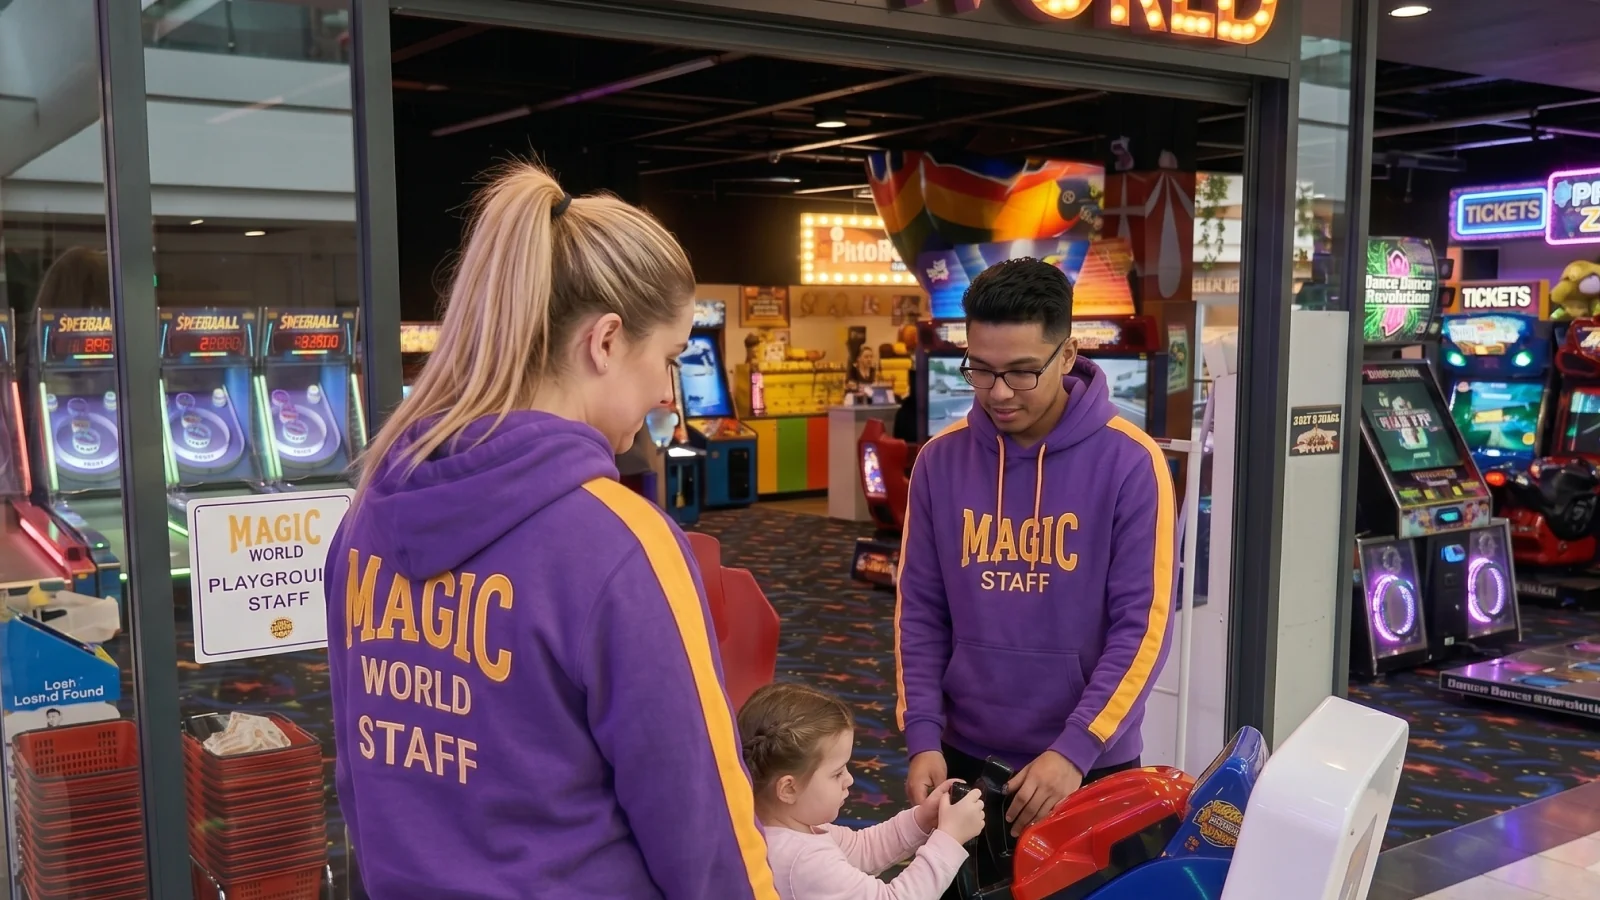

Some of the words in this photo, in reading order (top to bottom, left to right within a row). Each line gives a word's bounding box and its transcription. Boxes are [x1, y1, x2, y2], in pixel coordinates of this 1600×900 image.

[1465, 200, 1540, 224] TICKETS
[1365, 274, 1399, 290] Dance
[1365, 289, 1430, 304] Revolution
[1462, 286, 1531, 308] TICKETS
[228, 508, 321, 554] MAGIC
[961, 508, 1079, 572] MAGIC
[249, 545, 304, 562] WORLD
[981, 571, 1050, 593] STAFF
[249, 591, 310, 611] STAFF
[346, 548, 514, 683] MAGIC
[62, 685, 104, 700] Found
[360, 655, 472, 716] WORLD
[359, 714, 478, 785] STAFF
